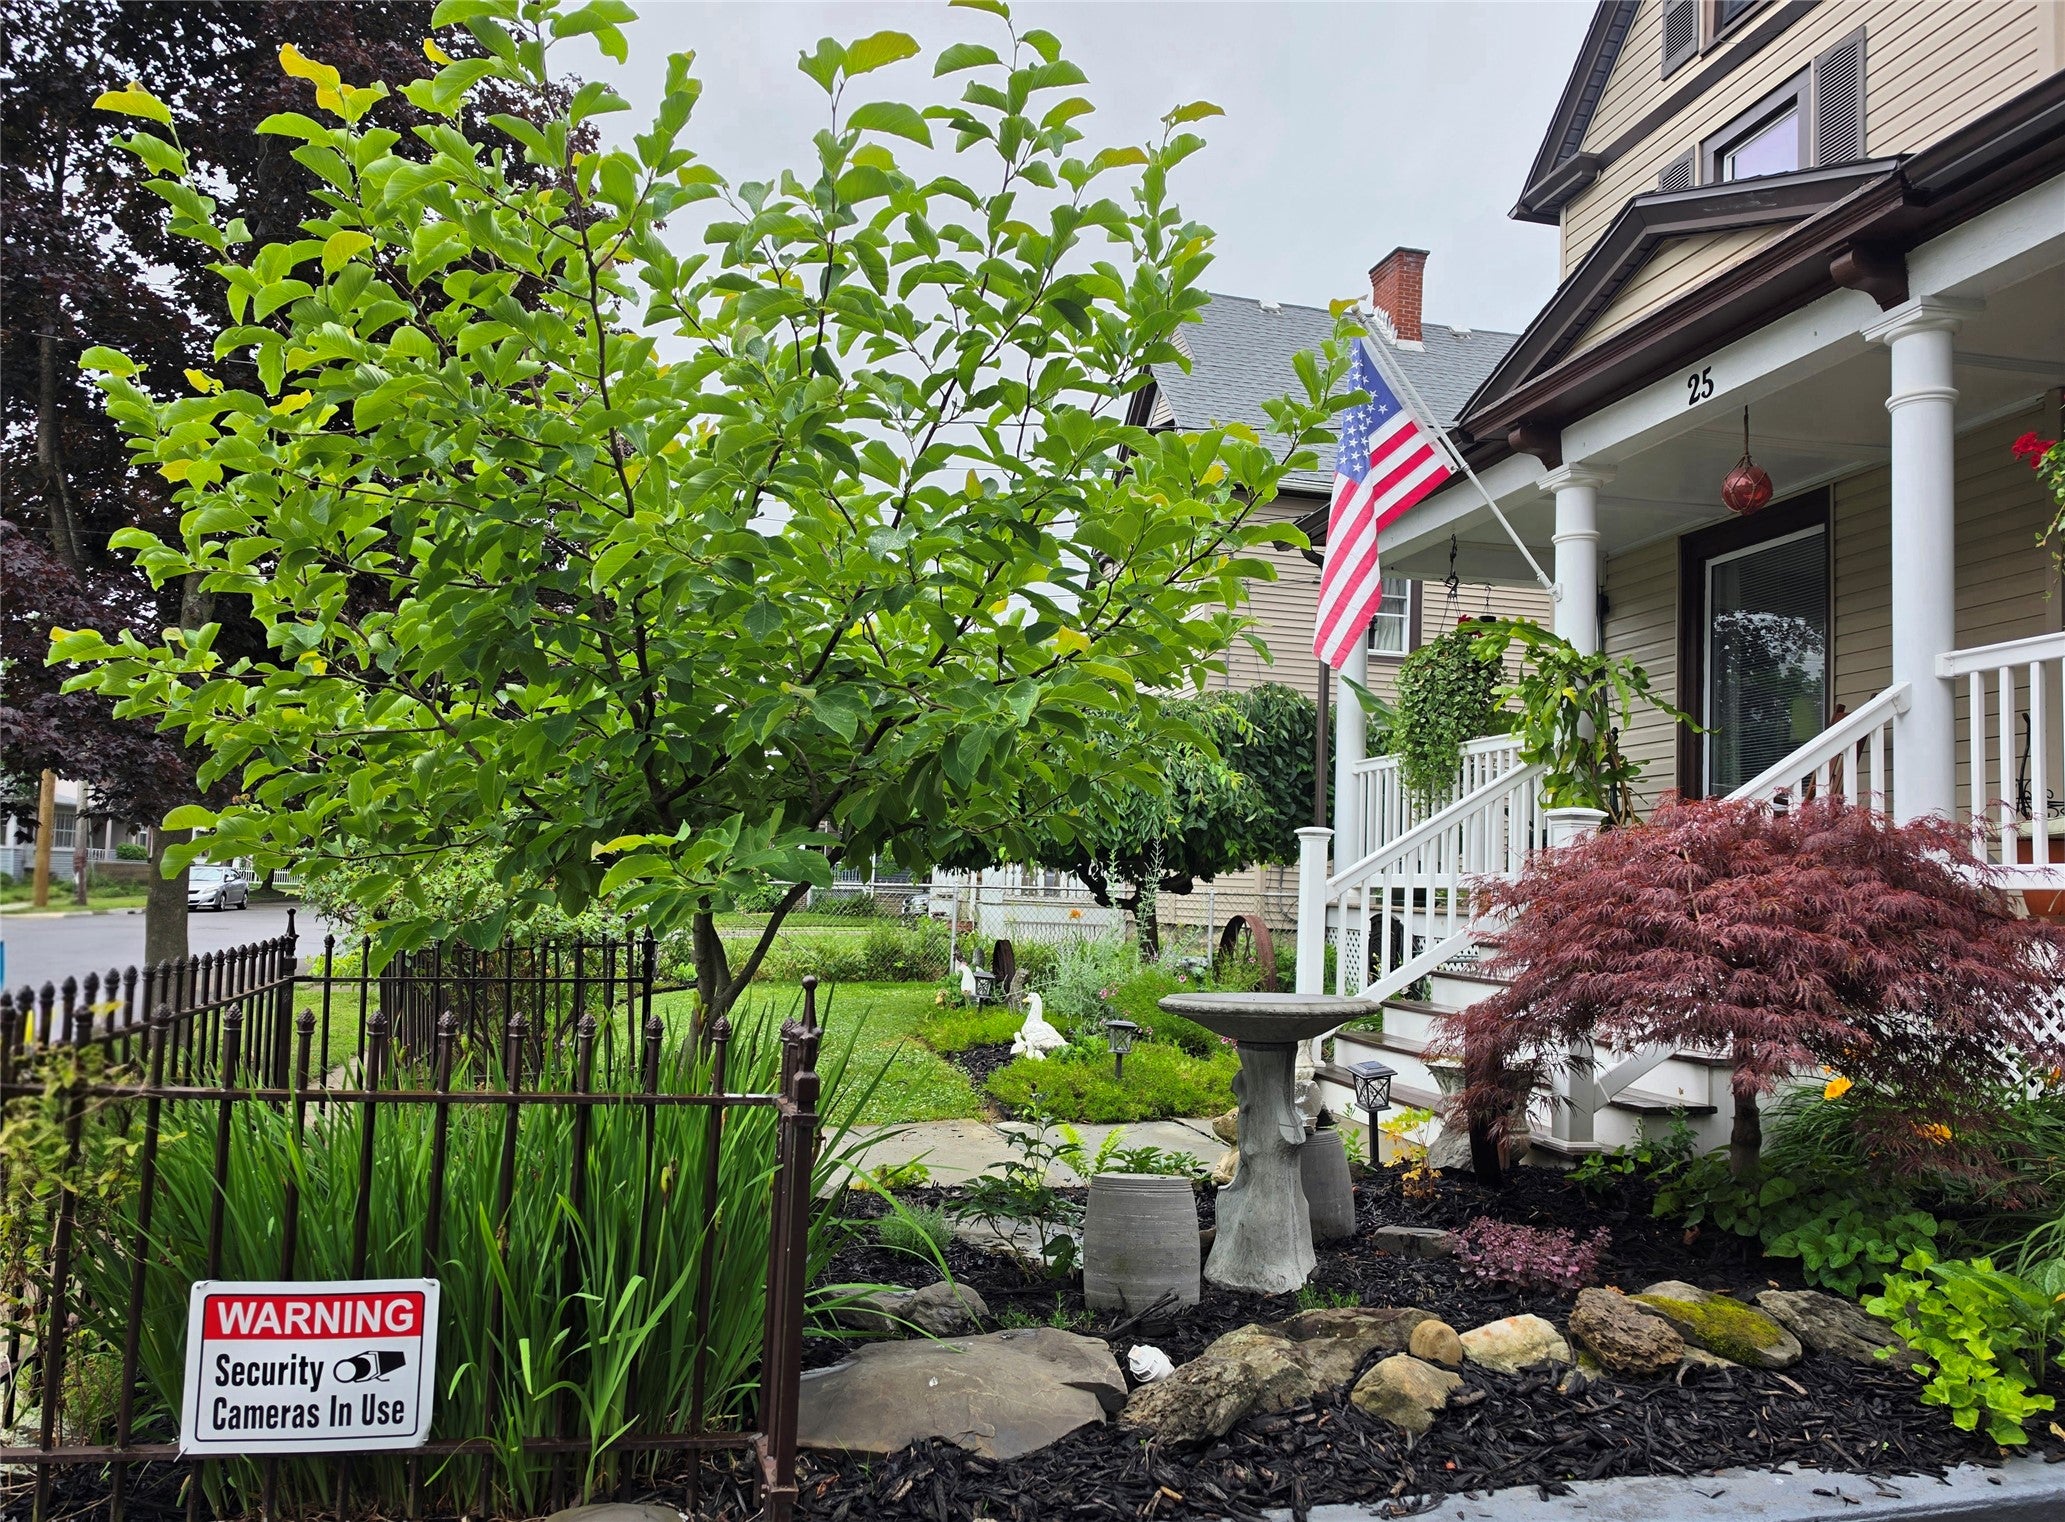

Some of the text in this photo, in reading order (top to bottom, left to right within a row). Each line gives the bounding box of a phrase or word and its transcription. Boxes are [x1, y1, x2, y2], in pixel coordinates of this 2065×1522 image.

[1687, 366, 1714, 406] 25
[217, 1298, 414, 1335] WARNING
[215, 1353, 324, 1392] Security
[213, 1393, 405, 1430] Cameras In Use
